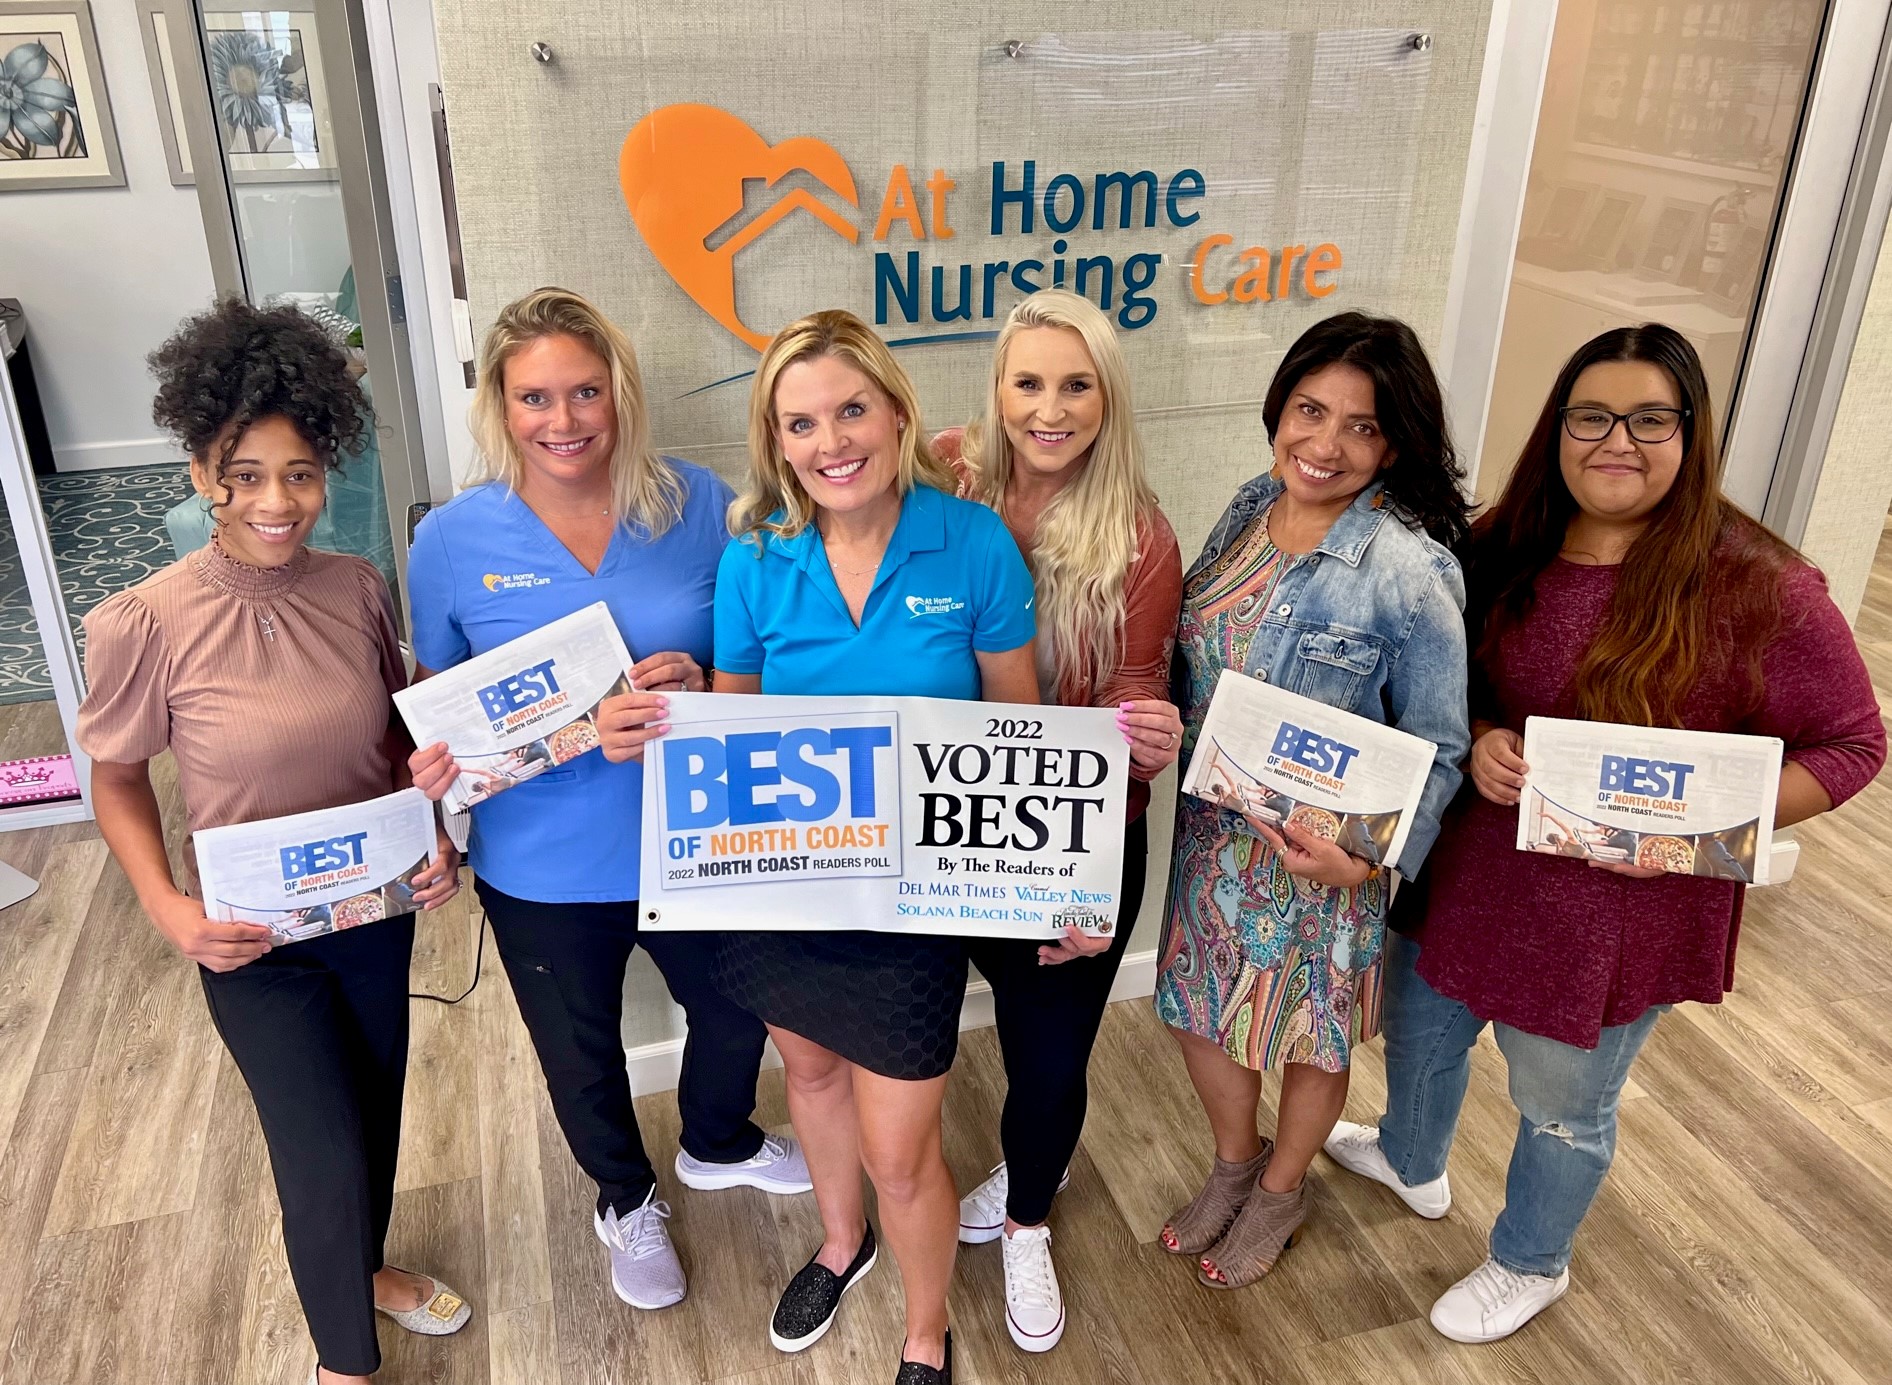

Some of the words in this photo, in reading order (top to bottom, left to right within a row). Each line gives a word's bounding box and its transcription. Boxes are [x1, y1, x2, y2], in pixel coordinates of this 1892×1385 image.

[873, 164, 956, 241] At
[991, 160, 1206, 236] Home
[875, 239, 1162, 329] Nursing
[1191, 233, 1343, 305] Care
[504, 580, 532, 588] Nursing
[925, 604, 950, 612] Nursing
[934, 596, 952, 604] Home
[476, 658, 562, 722] BEST
[492, 720, 505, 733] OF
[506, 706, 538, 726] NORTH
[538, 691, 569, 712] COAST
[506, 722, 526, 735] NORTH
[526, 714, 545, 726] COAST
[984, 718, 1043, 739] 2022
[1270, 721, 1360, 780] BEST
[913, 744, 1109, 788] VOTED
[1266, 755, 1281, 766] OF
[1281, 760, 1313, 780] NORTH
[1314, 772, 1346, 791] COAST
[1600, 754, 1694, 800] BEST
[662, 726, 892, 832] BEST
[1274, 768, 1294, 780] NORTH
[1294, 776, 1314, 788] COAST
[1598, 792, 1612, 802] OF
[1614, 794, 1649, 808] NORTH
[1652, 799, 1688, 812] COAST
[1608, 804, 1630, 813] NORTH
[1630, 808, 1652, 816] COAST
[916, 793, 1104, 853] BEST
[668, 836, 701, 860] OF
[710, 828, 796, 856] NORTH
[806, 824, 889, 850] COAST
[280, 832, 368, 880] BEST
[937, 857, 957, 875] By
[962, 858, 990, 872] The
[995, 859, 1054, 876] Readers
[1059, 862, 1076, 877] of
[284, 880, 298, 892] OF
[300, 872, 334, 888] NORTH
[337, 864, 369, 880] COAST
[668, 868, 694, 880] 2022
[698, 860, 752, 878] NORTH
[757, 856, 810, 873] COAST
[814, 858, 862, 870] READERS
[864, 857, 890, 868] POLL
[296, 887, 318, 896] NORTH
[319, 881, 340, 890] COAST
[899, 882, 924, 896] DEL
[928, 882, 960, 897] MAR
[964, 884, 1006, 898] TIMES
[1014, 886, 1067, 902] VALLEY
[1070, 890, 1112, 904] NEWS
[896, 903, 954, 917] SOLANA
[960, 905, 1008, 921] BEACH
[1012, 908, 1043, 922] SUN
[1052, 914, 1109, 928] REVIEW
